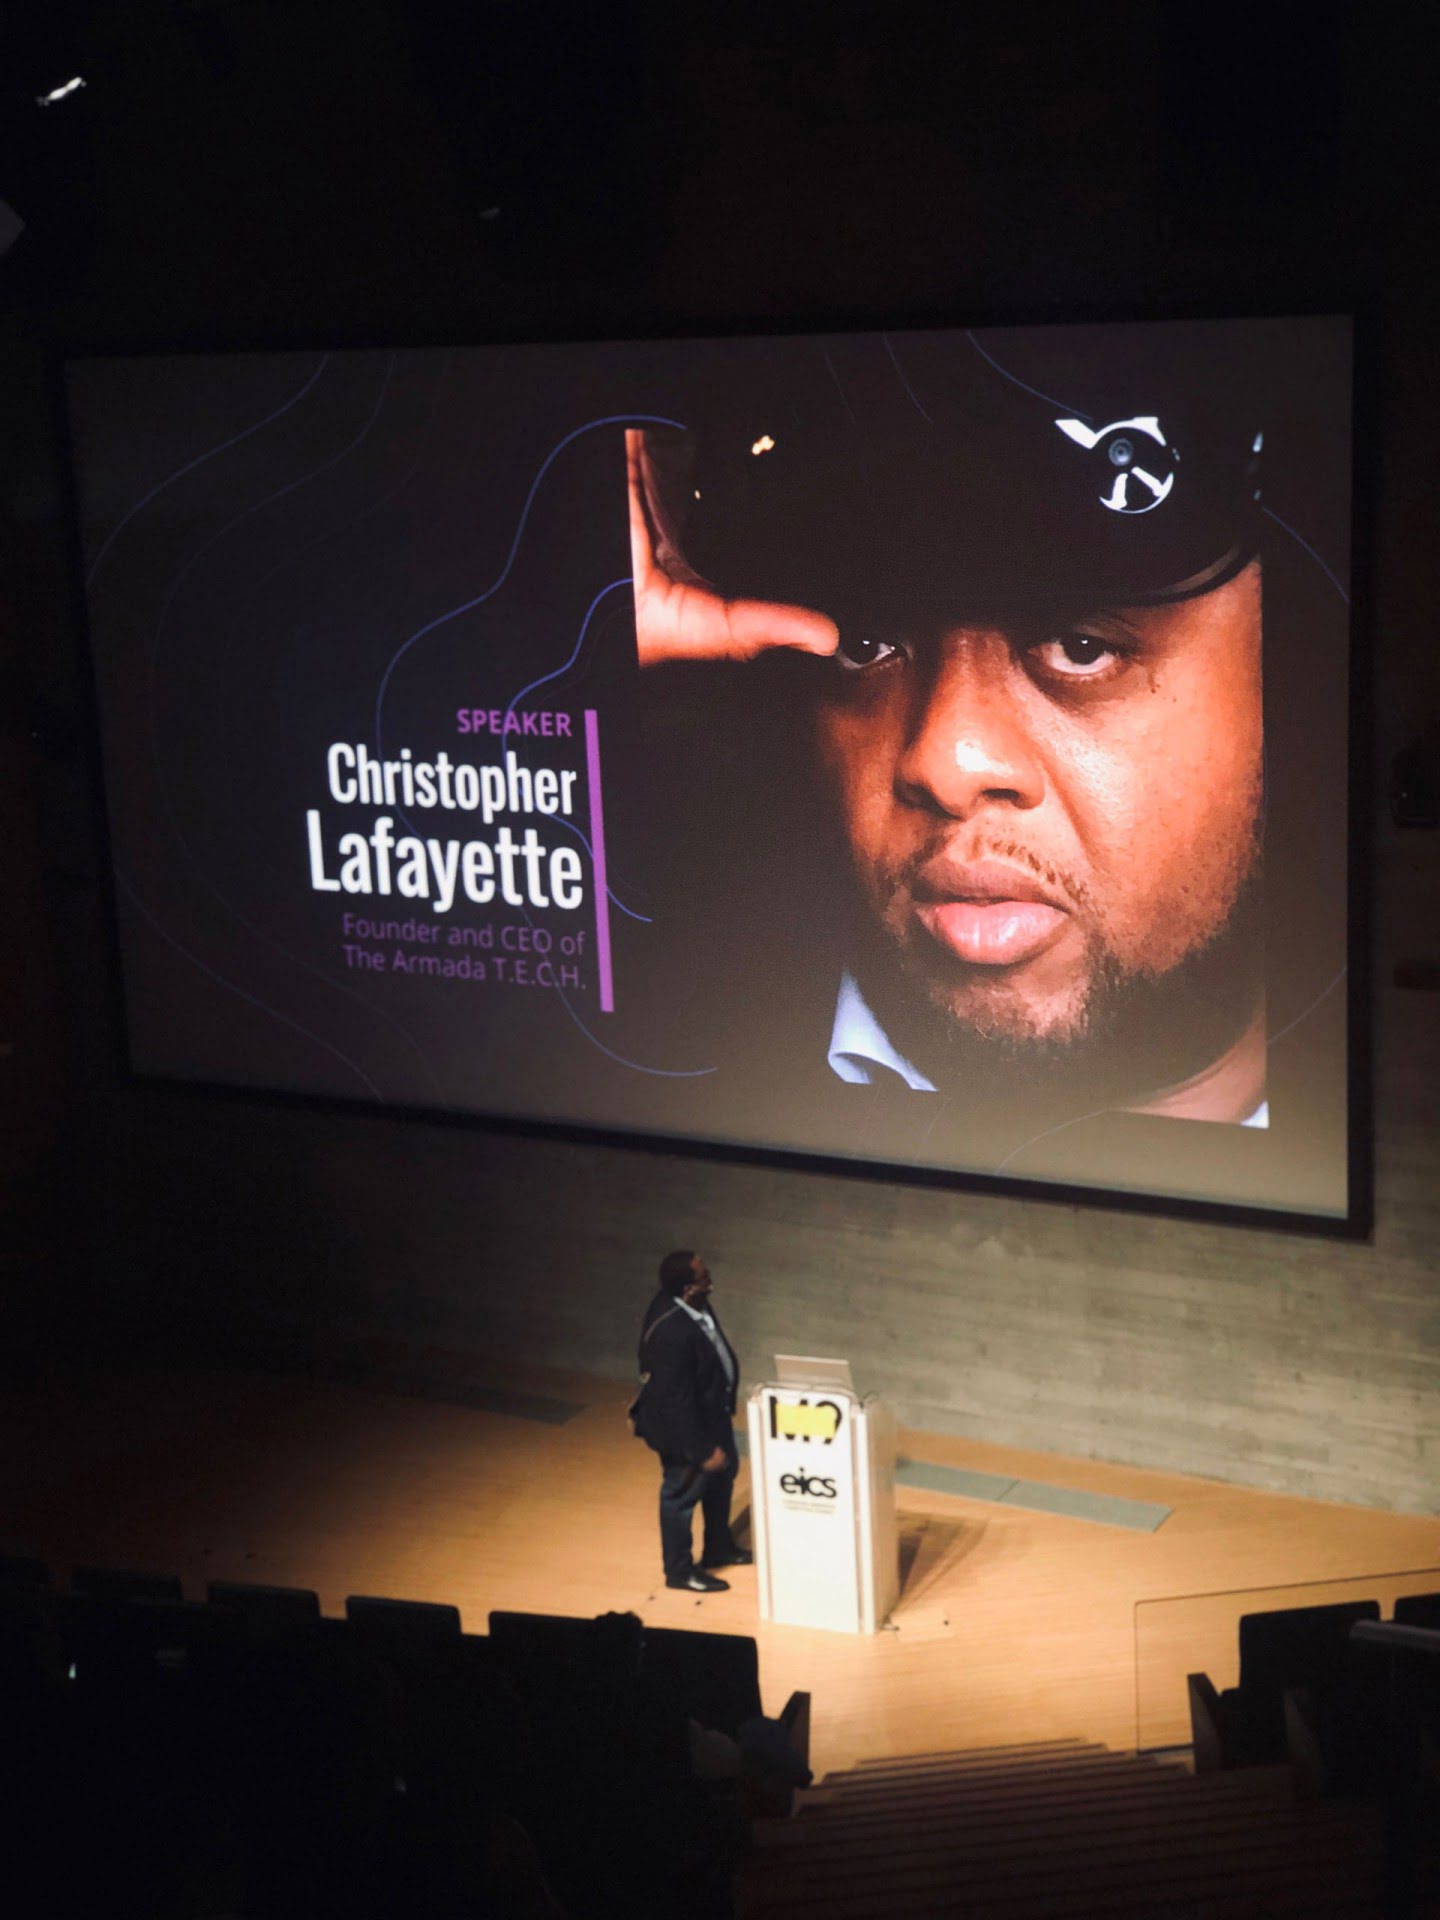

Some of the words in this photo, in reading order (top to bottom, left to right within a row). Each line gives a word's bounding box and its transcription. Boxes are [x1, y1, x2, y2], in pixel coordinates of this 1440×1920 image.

[457, 708, 573, 737] SPEAKER
[327, 742, 577, 824] Christopher
[306, 809, 583, 913] Lafayette
[342, 912, 440, 944] Founder
[447, 924, 494, 949] and
[501, 925, 552, 953] CEO
[560, 931, 586, 956] of
[342, 944, 385, 972] The
[392, 949, 486, 982] Armada
[493, 957, 587, 990] T.E.C.H.
[779, 1467, 838, 1498] eics
